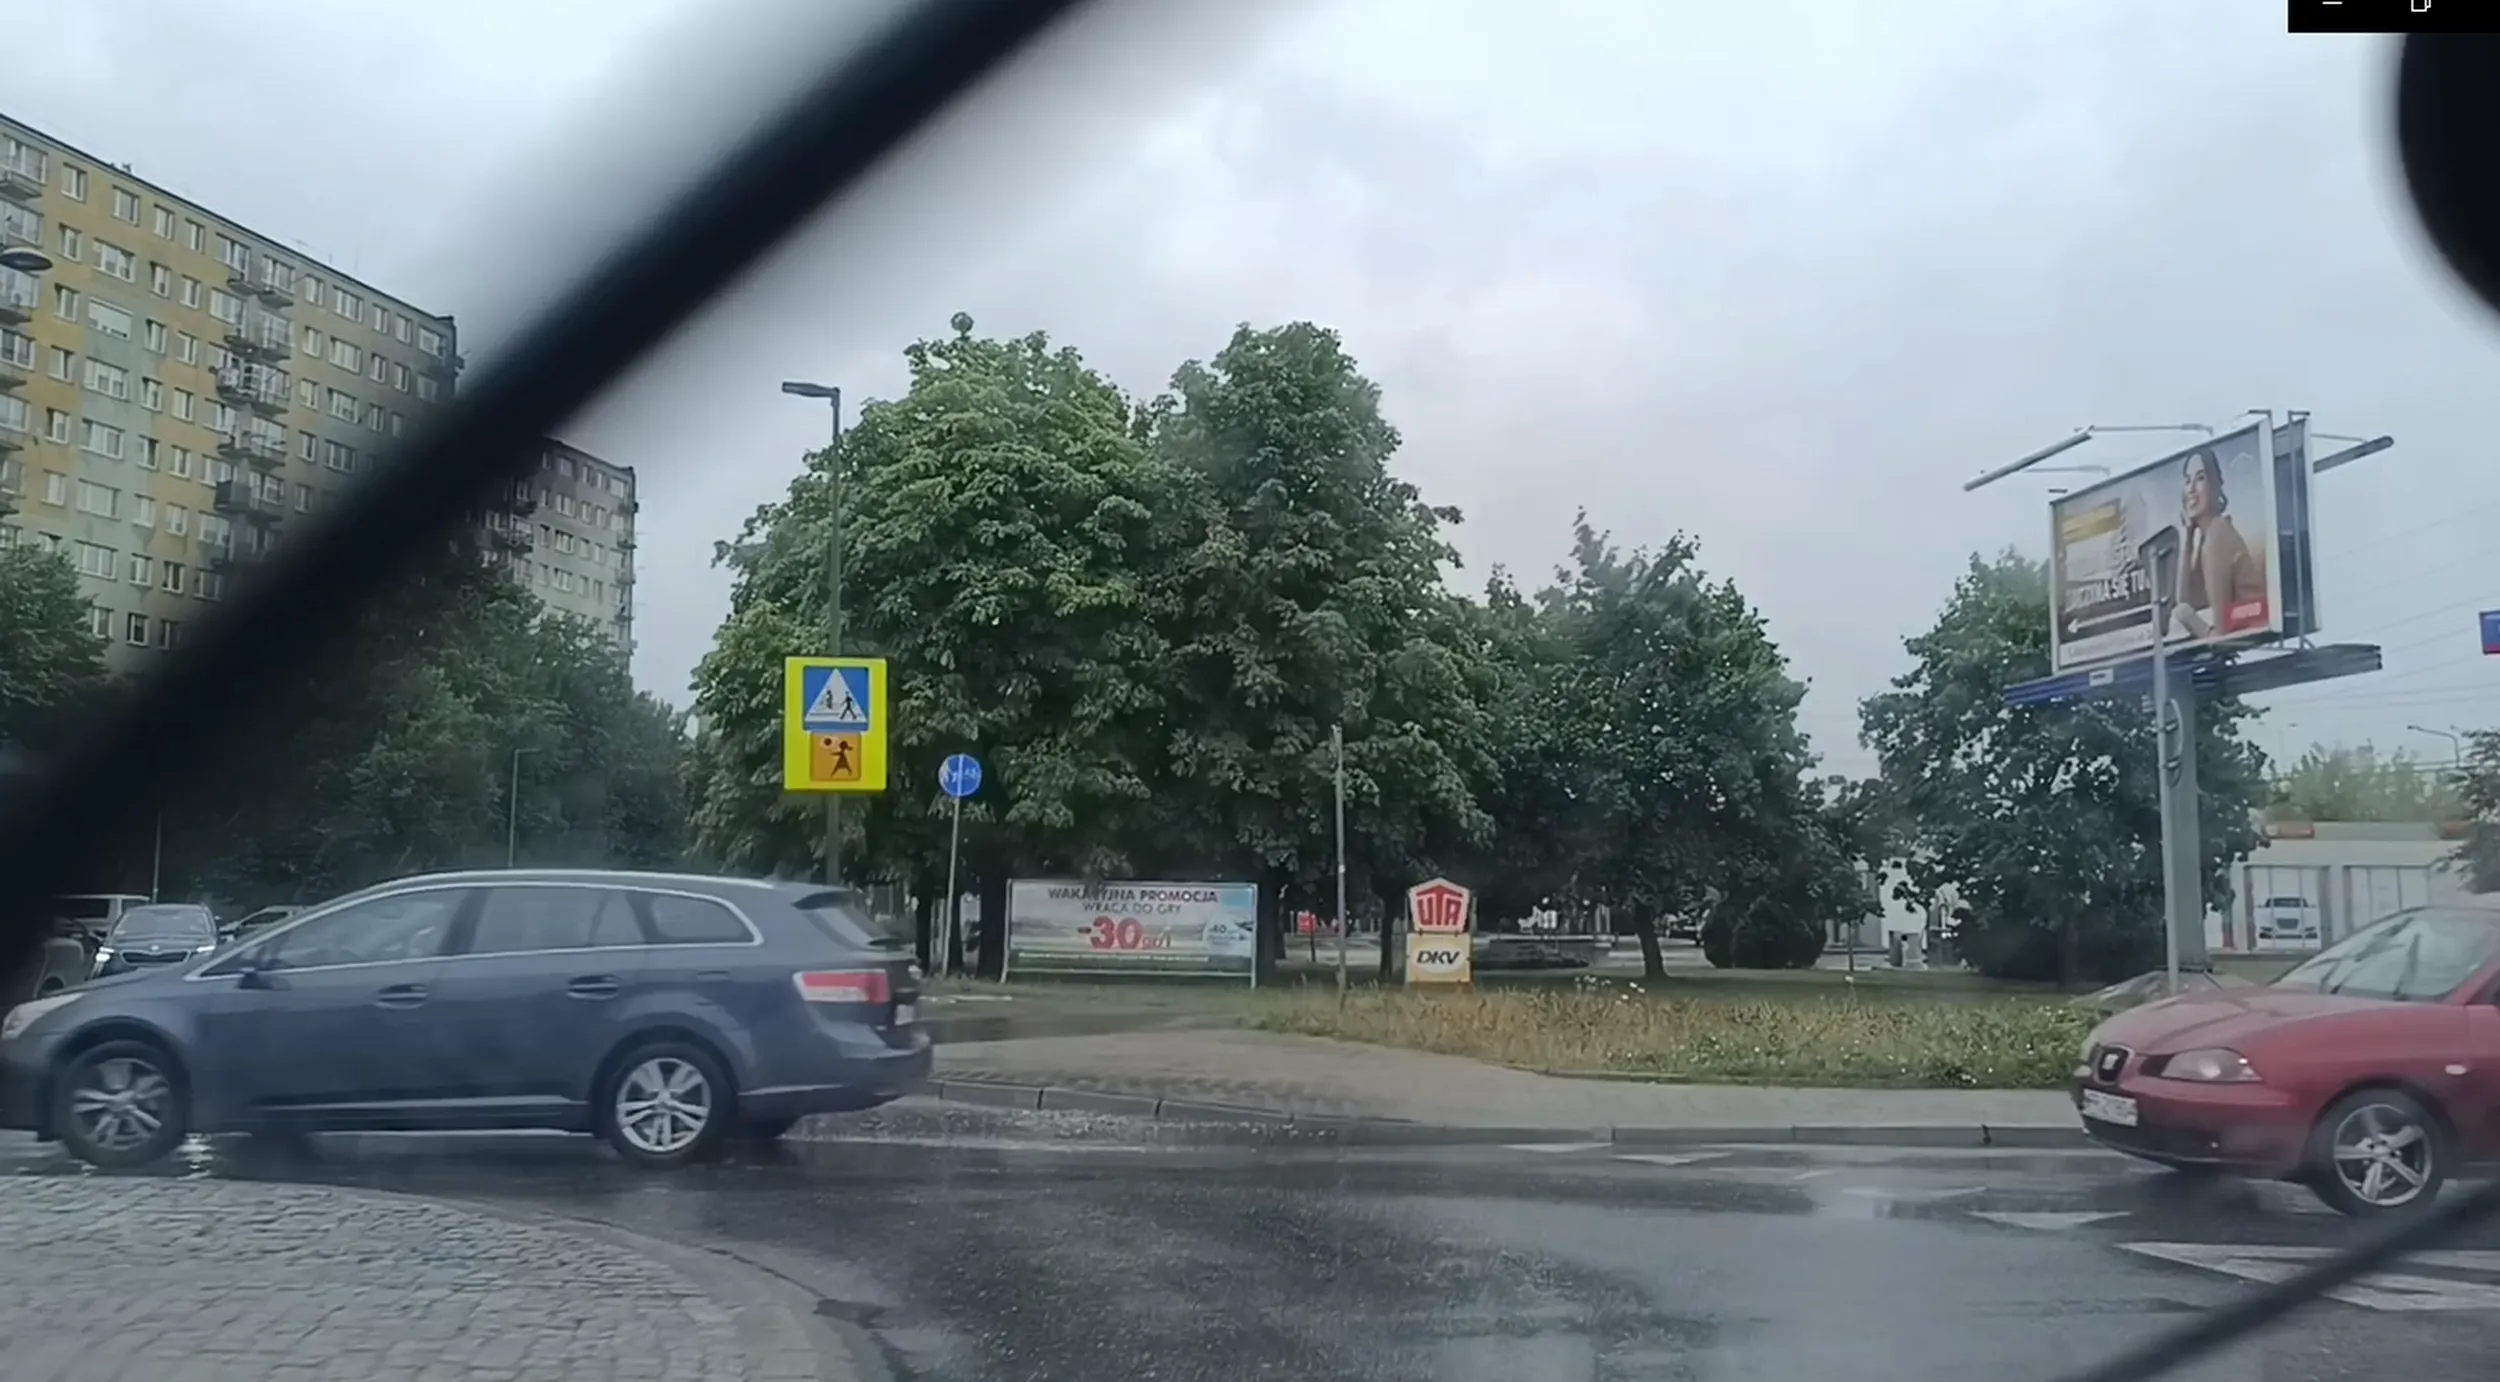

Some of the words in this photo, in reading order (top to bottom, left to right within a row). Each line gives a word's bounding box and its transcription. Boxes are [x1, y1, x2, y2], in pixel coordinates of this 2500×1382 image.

[1047, 887, 1136, 901] WAKAYJNA
[1140, 889, 1218, 903] PROMOCJA
[1132, 903, 1153, 914] DO
[1157, 903, 1182, 915] GRY
[1416, 884, 1463, 926] UTA
[1077, 915, 1143, 950] -30
[1416, 950, 1461, 965] DKV
